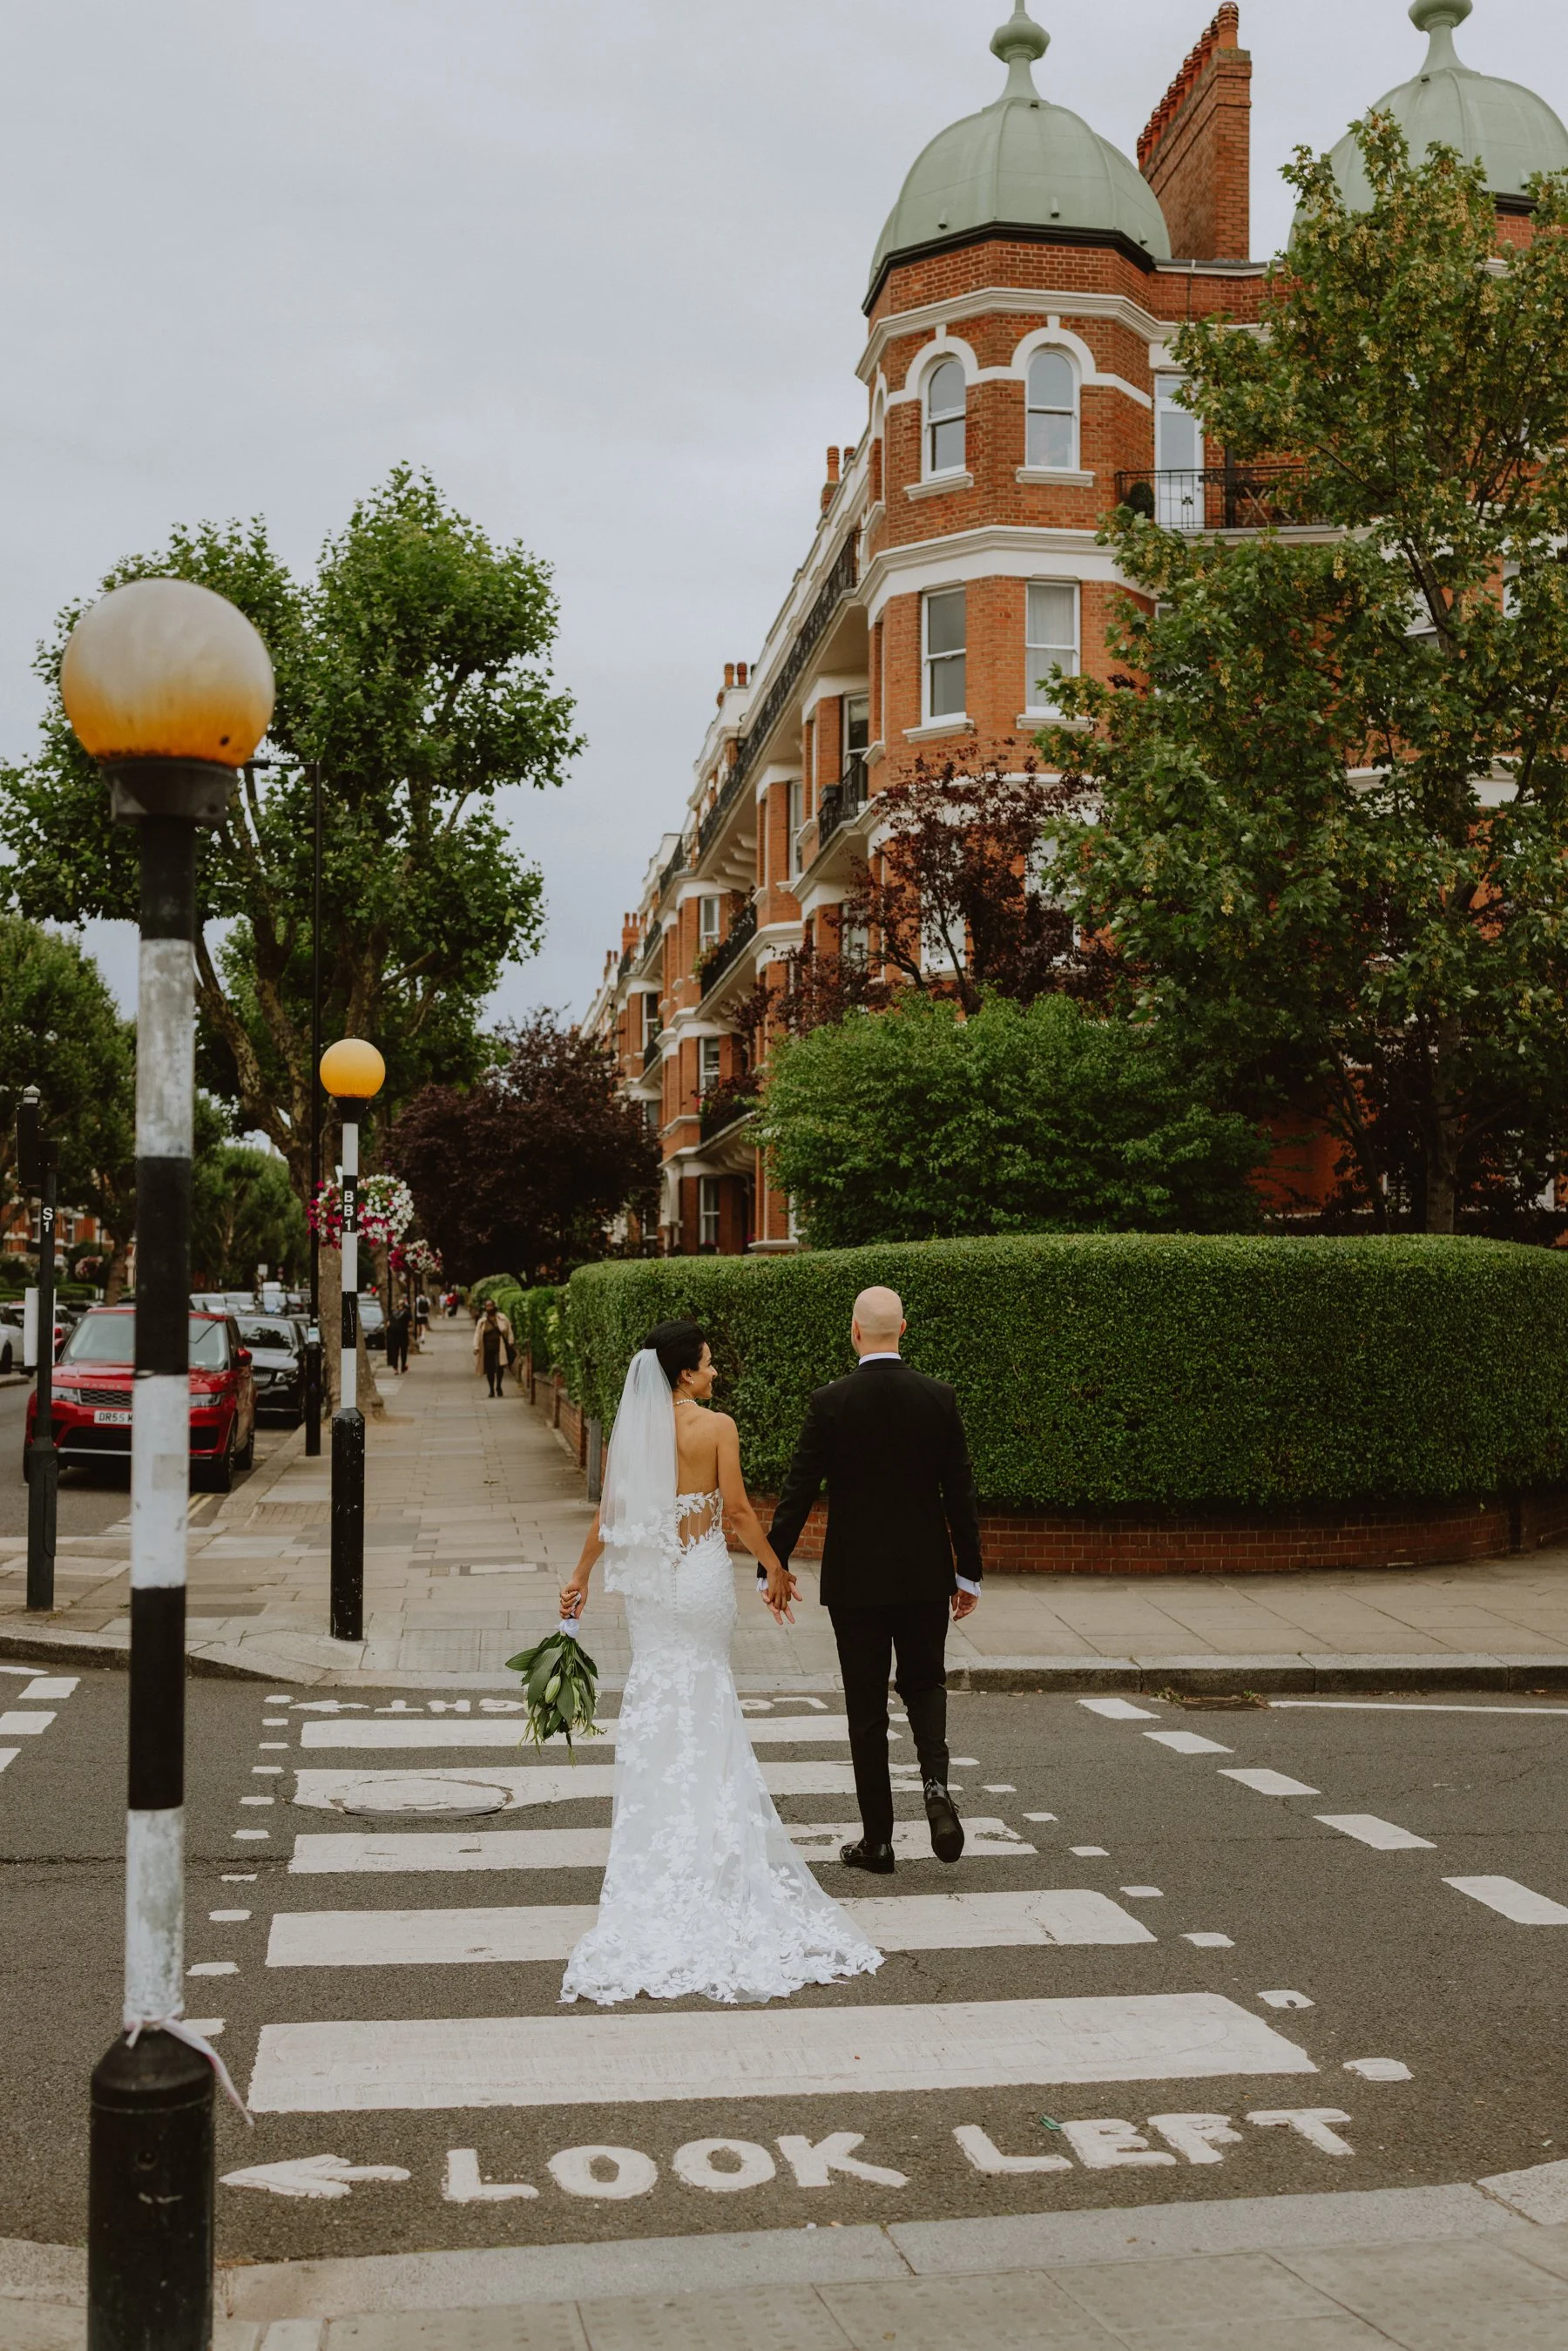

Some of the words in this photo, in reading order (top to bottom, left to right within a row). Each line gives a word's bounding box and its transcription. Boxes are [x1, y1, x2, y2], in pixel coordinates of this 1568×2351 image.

[42, 1206, 54, 1233] S1
[343, 1190, 355, 1232] BB1
[442, 2131, 911, 2202] LOOK
[952, 2107, 1355, 2173] LEFT
